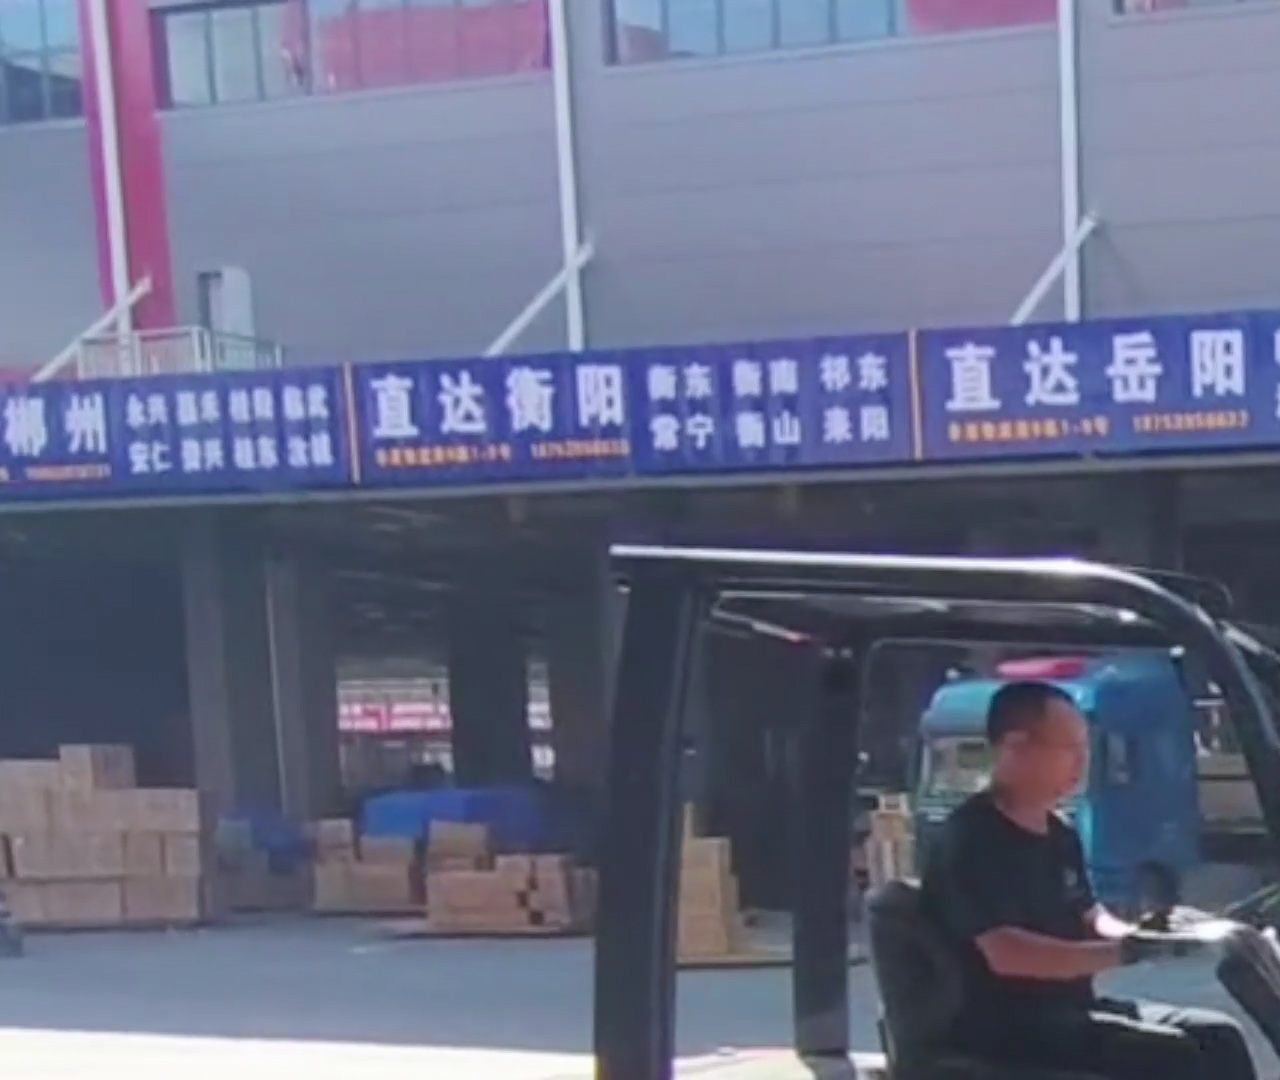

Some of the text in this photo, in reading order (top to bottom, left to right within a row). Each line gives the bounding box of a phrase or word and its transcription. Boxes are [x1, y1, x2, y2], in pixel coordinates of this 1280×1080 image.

[371, 365, 624, 437] 直达衡阳
[946, 330, 1244, 411] 直达岳阳
[4, 393, 106, 456] 郴州
